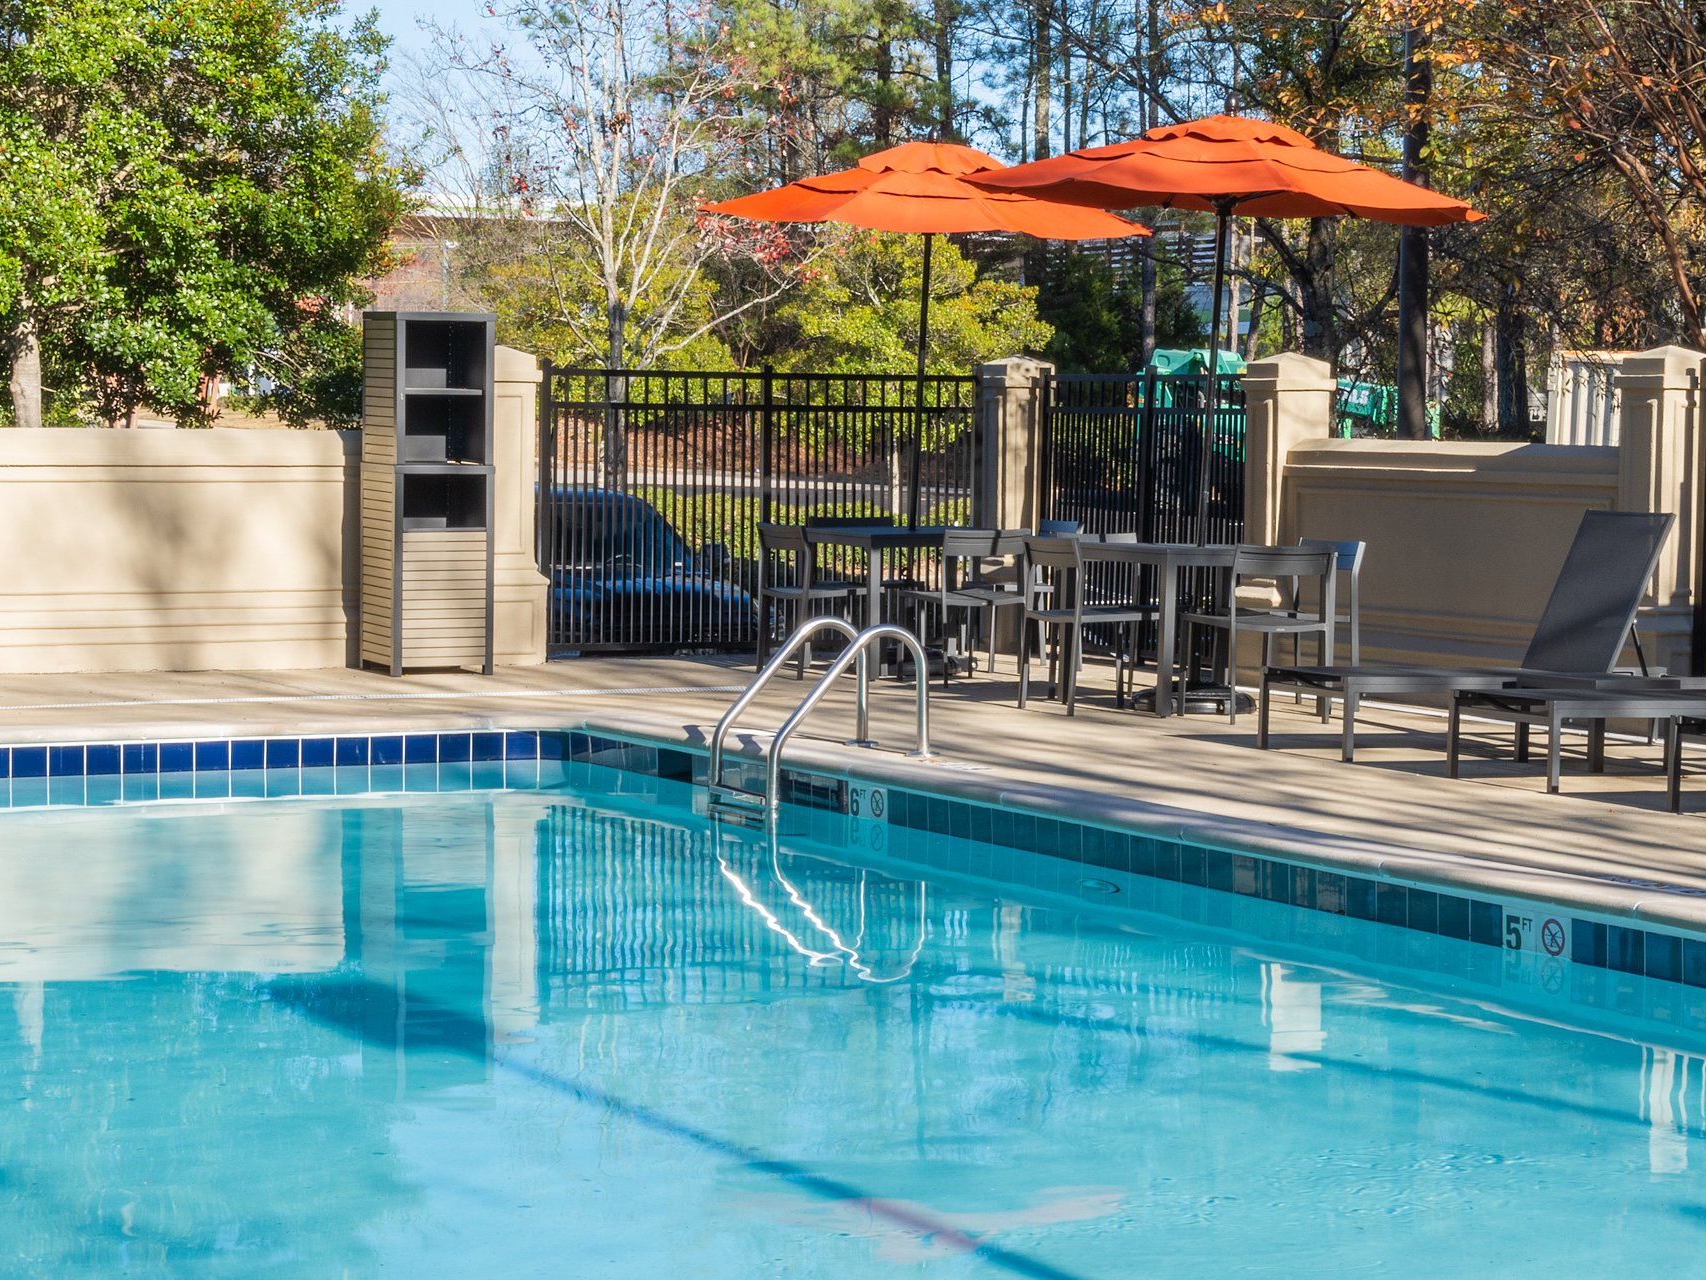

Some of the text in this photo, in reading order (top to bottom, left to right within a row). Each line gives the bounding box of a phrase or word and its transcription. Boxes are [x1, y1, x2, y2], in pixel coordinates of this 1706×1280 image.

[850, 787, 867, 817] 6 FT
[1505, 914, 1533, 951] 5 FT
